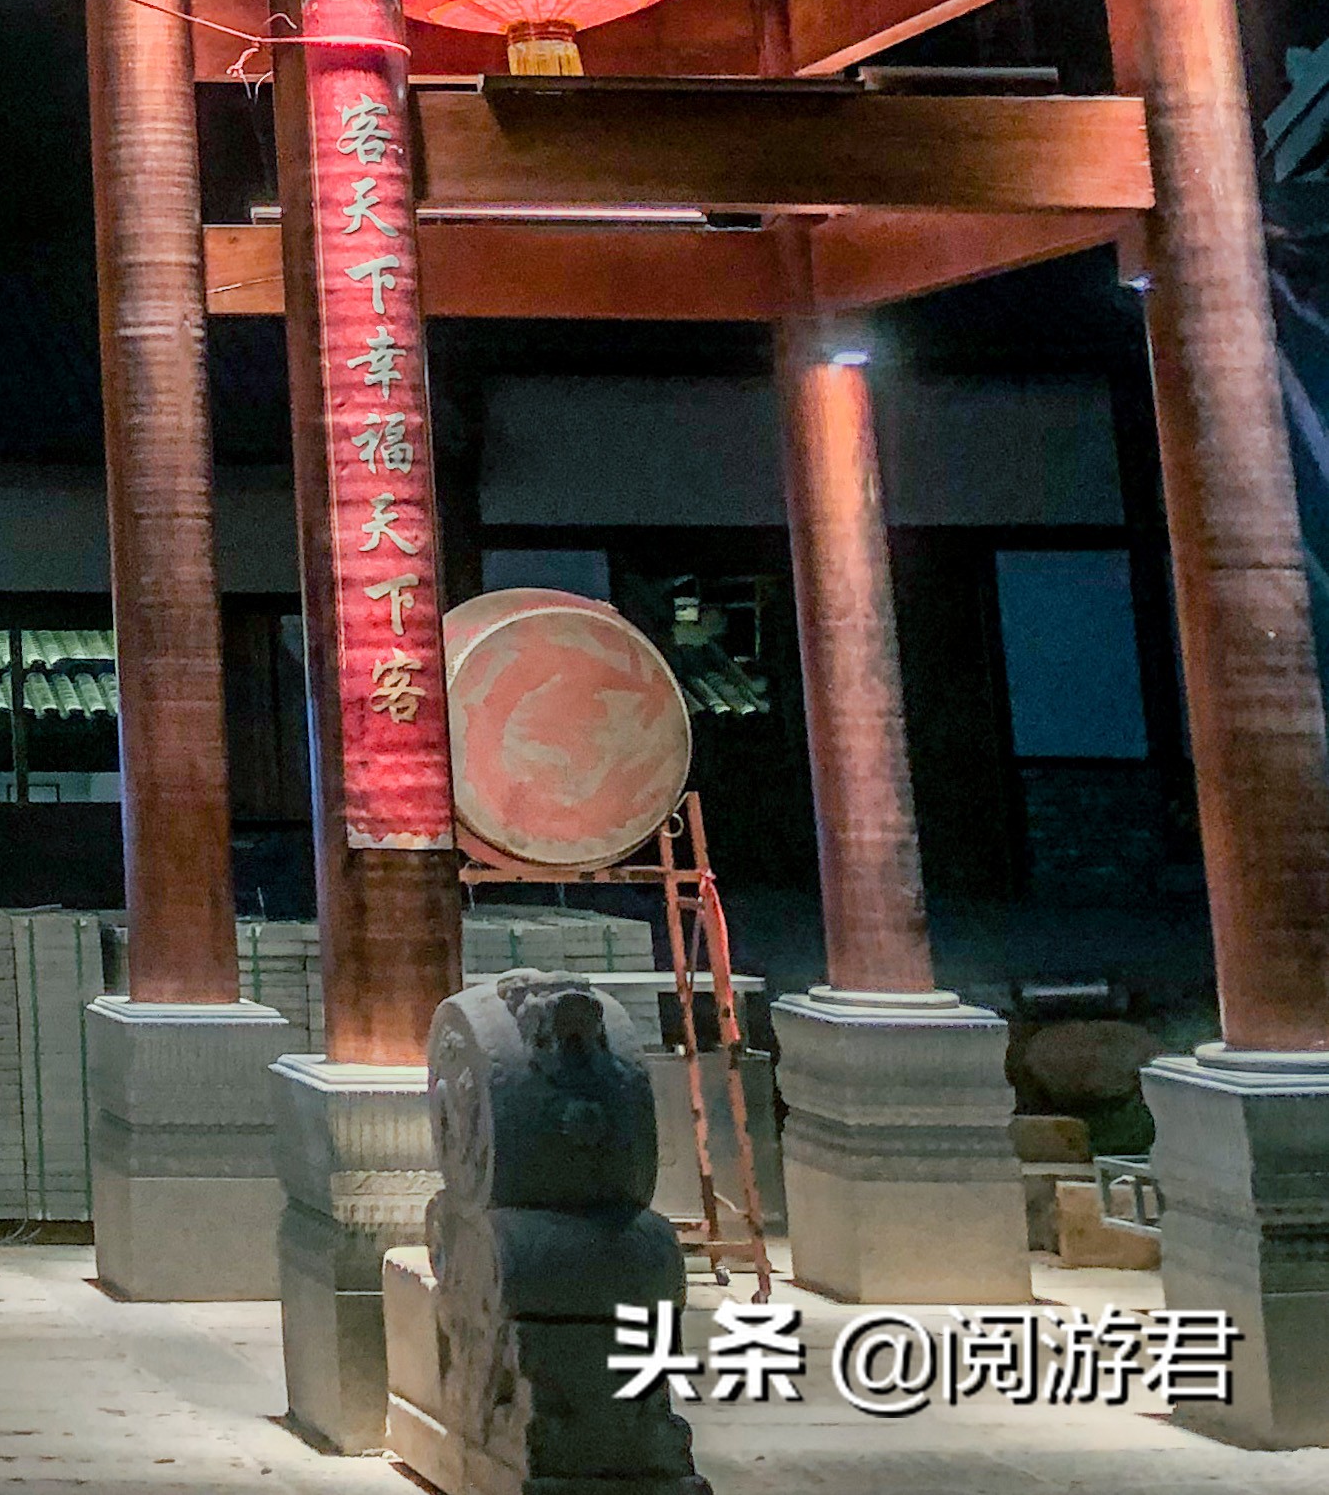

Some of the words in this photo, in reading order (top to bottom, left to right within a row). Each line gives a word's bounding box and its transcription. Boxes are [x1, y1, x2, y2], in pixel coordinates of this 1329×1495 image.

[336, 94, 427, 725] 客天下幸福天下客
